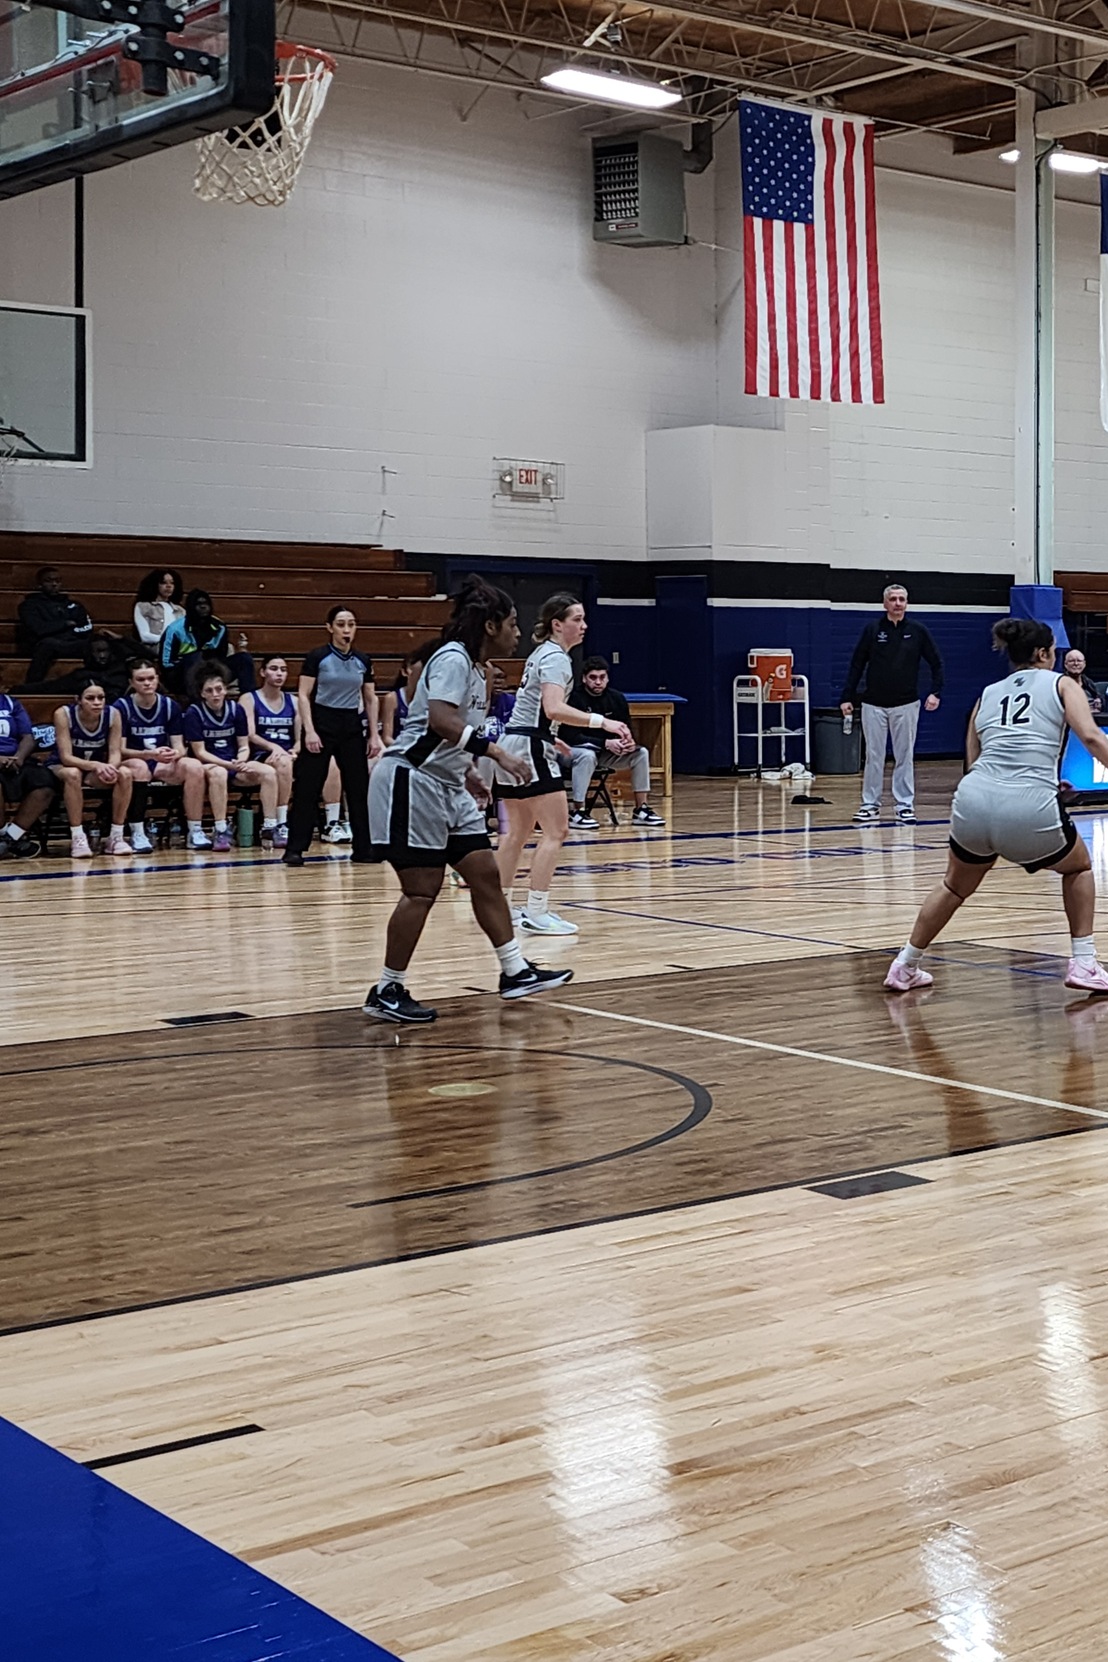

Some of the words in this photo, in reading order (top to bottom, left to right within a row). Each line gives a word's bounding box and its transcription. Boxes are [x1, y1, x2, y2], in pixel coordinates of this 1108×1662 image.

[518, 468, 539, 485] EXIT
[775, 664, 788, 679] G
[999, 692, 1032, 726] 12
